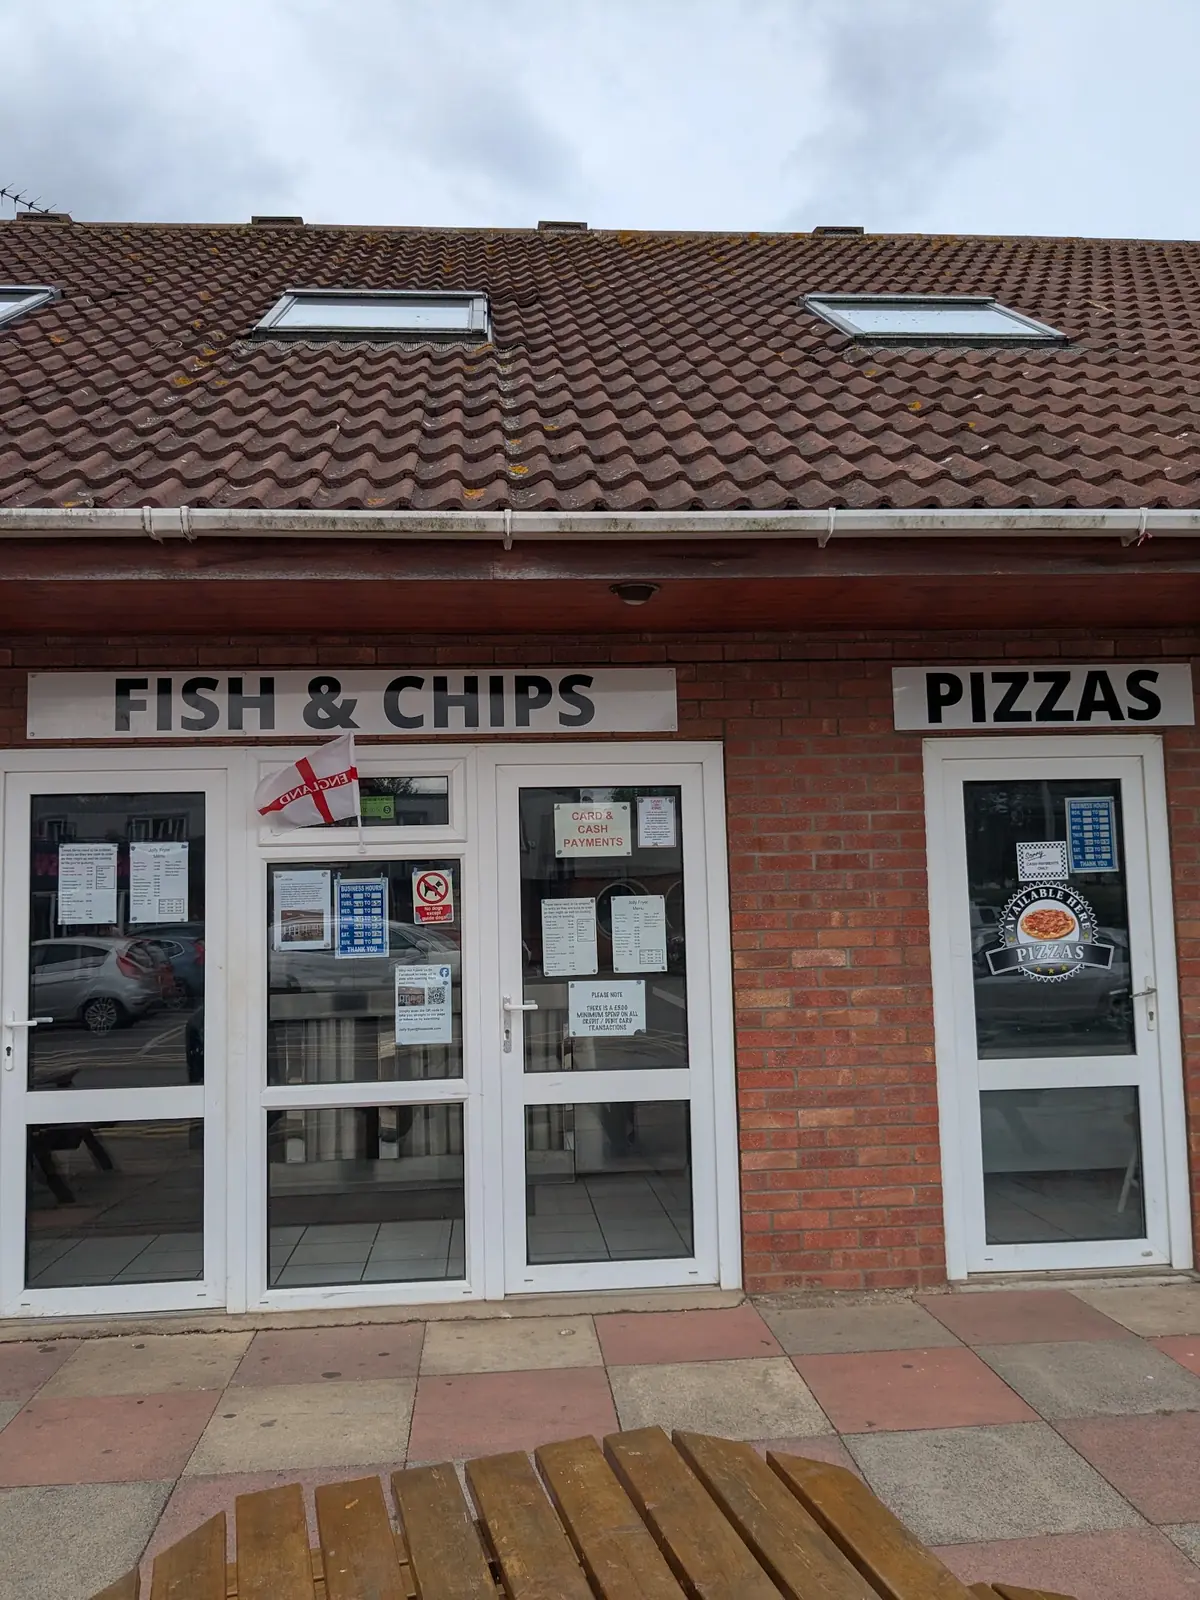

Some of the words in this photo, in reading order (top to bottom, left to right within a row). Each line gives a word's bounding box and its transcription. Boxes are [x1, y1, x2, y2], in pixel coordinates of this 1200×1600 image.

[114, 677, 275, 732] FISH
[302, 675, 360, 729] &
[384, 674, 595, 729] CHIPS
[926, 669, 1162, 724] PIZZAS
[572, 812, 602, 820] CARD
[606, 812, 613, 820] &
[578, 825, 608, 833] CASH
[564, 838, 623, 847] PAYMENTS
[1025, 851, 1044, 860] Sorry
[1006, 889, 1064, 932] AVAILABLE
[1067, 896, 1091, 929] HERE
[1016, 945, 1084, 962] PIZZAS
